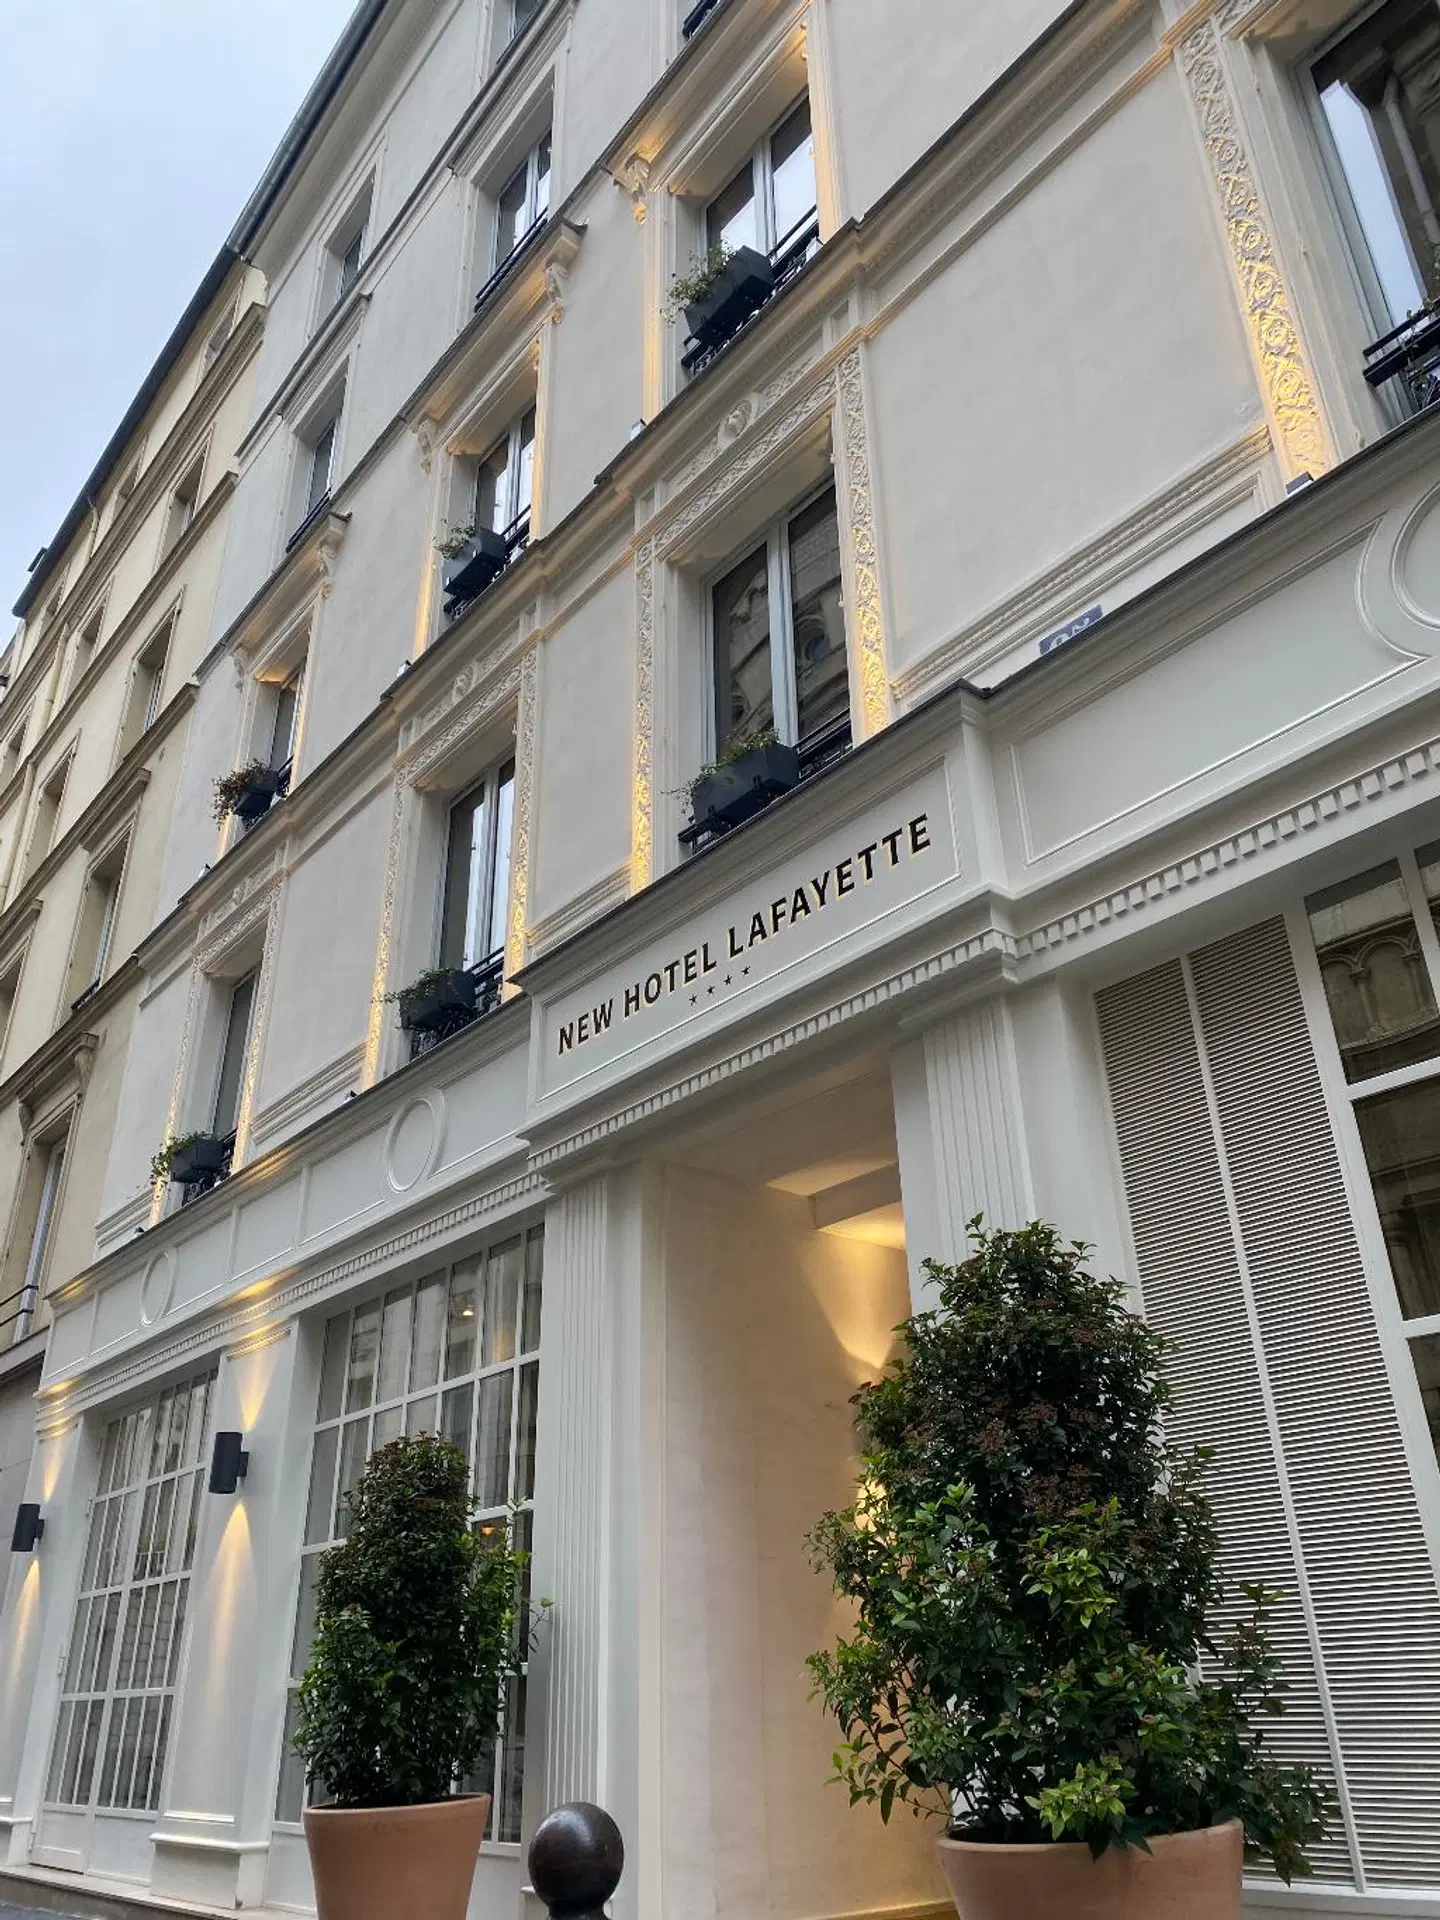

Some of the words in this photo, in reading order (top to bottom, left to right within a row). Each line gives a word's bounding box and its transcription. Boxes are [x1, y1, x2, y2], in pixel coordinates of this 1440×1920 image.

[558, 998, 613, 1056] NEW
[623, 942, 717, 1018] HOTEL
[727, 813, 931, 958] LAFAYETTE
